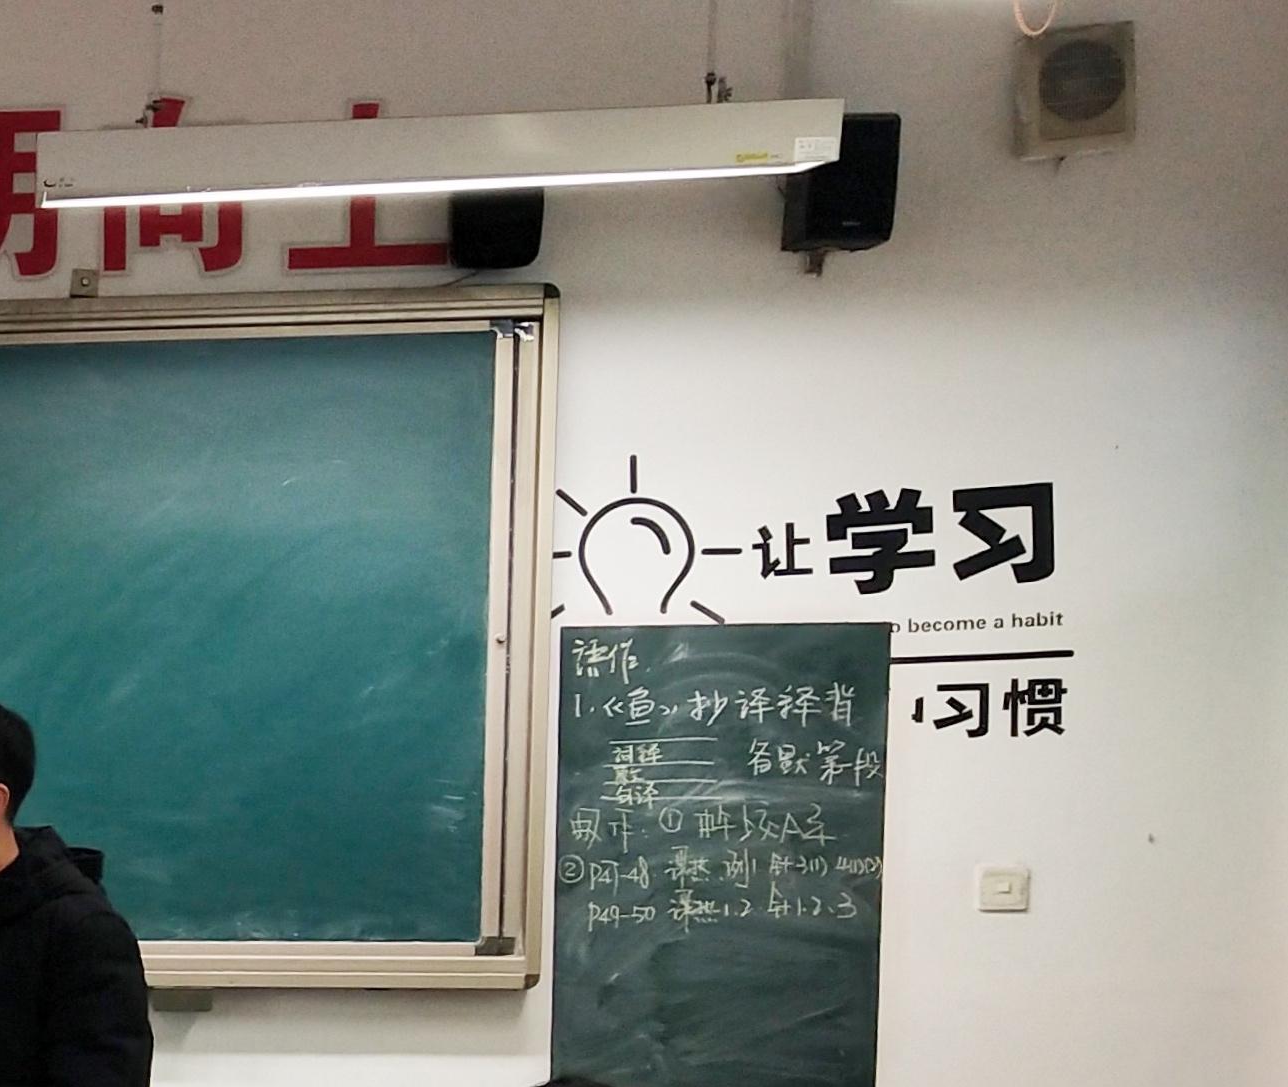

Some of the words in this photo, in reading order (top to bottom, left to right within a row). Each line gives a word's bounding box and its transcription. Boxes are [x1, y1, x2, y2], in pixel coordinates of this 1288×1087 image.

[908, 618, 987, 633] become
[994, 617, 1004, 629] a
[1011, 611, 1064, 628] habit
